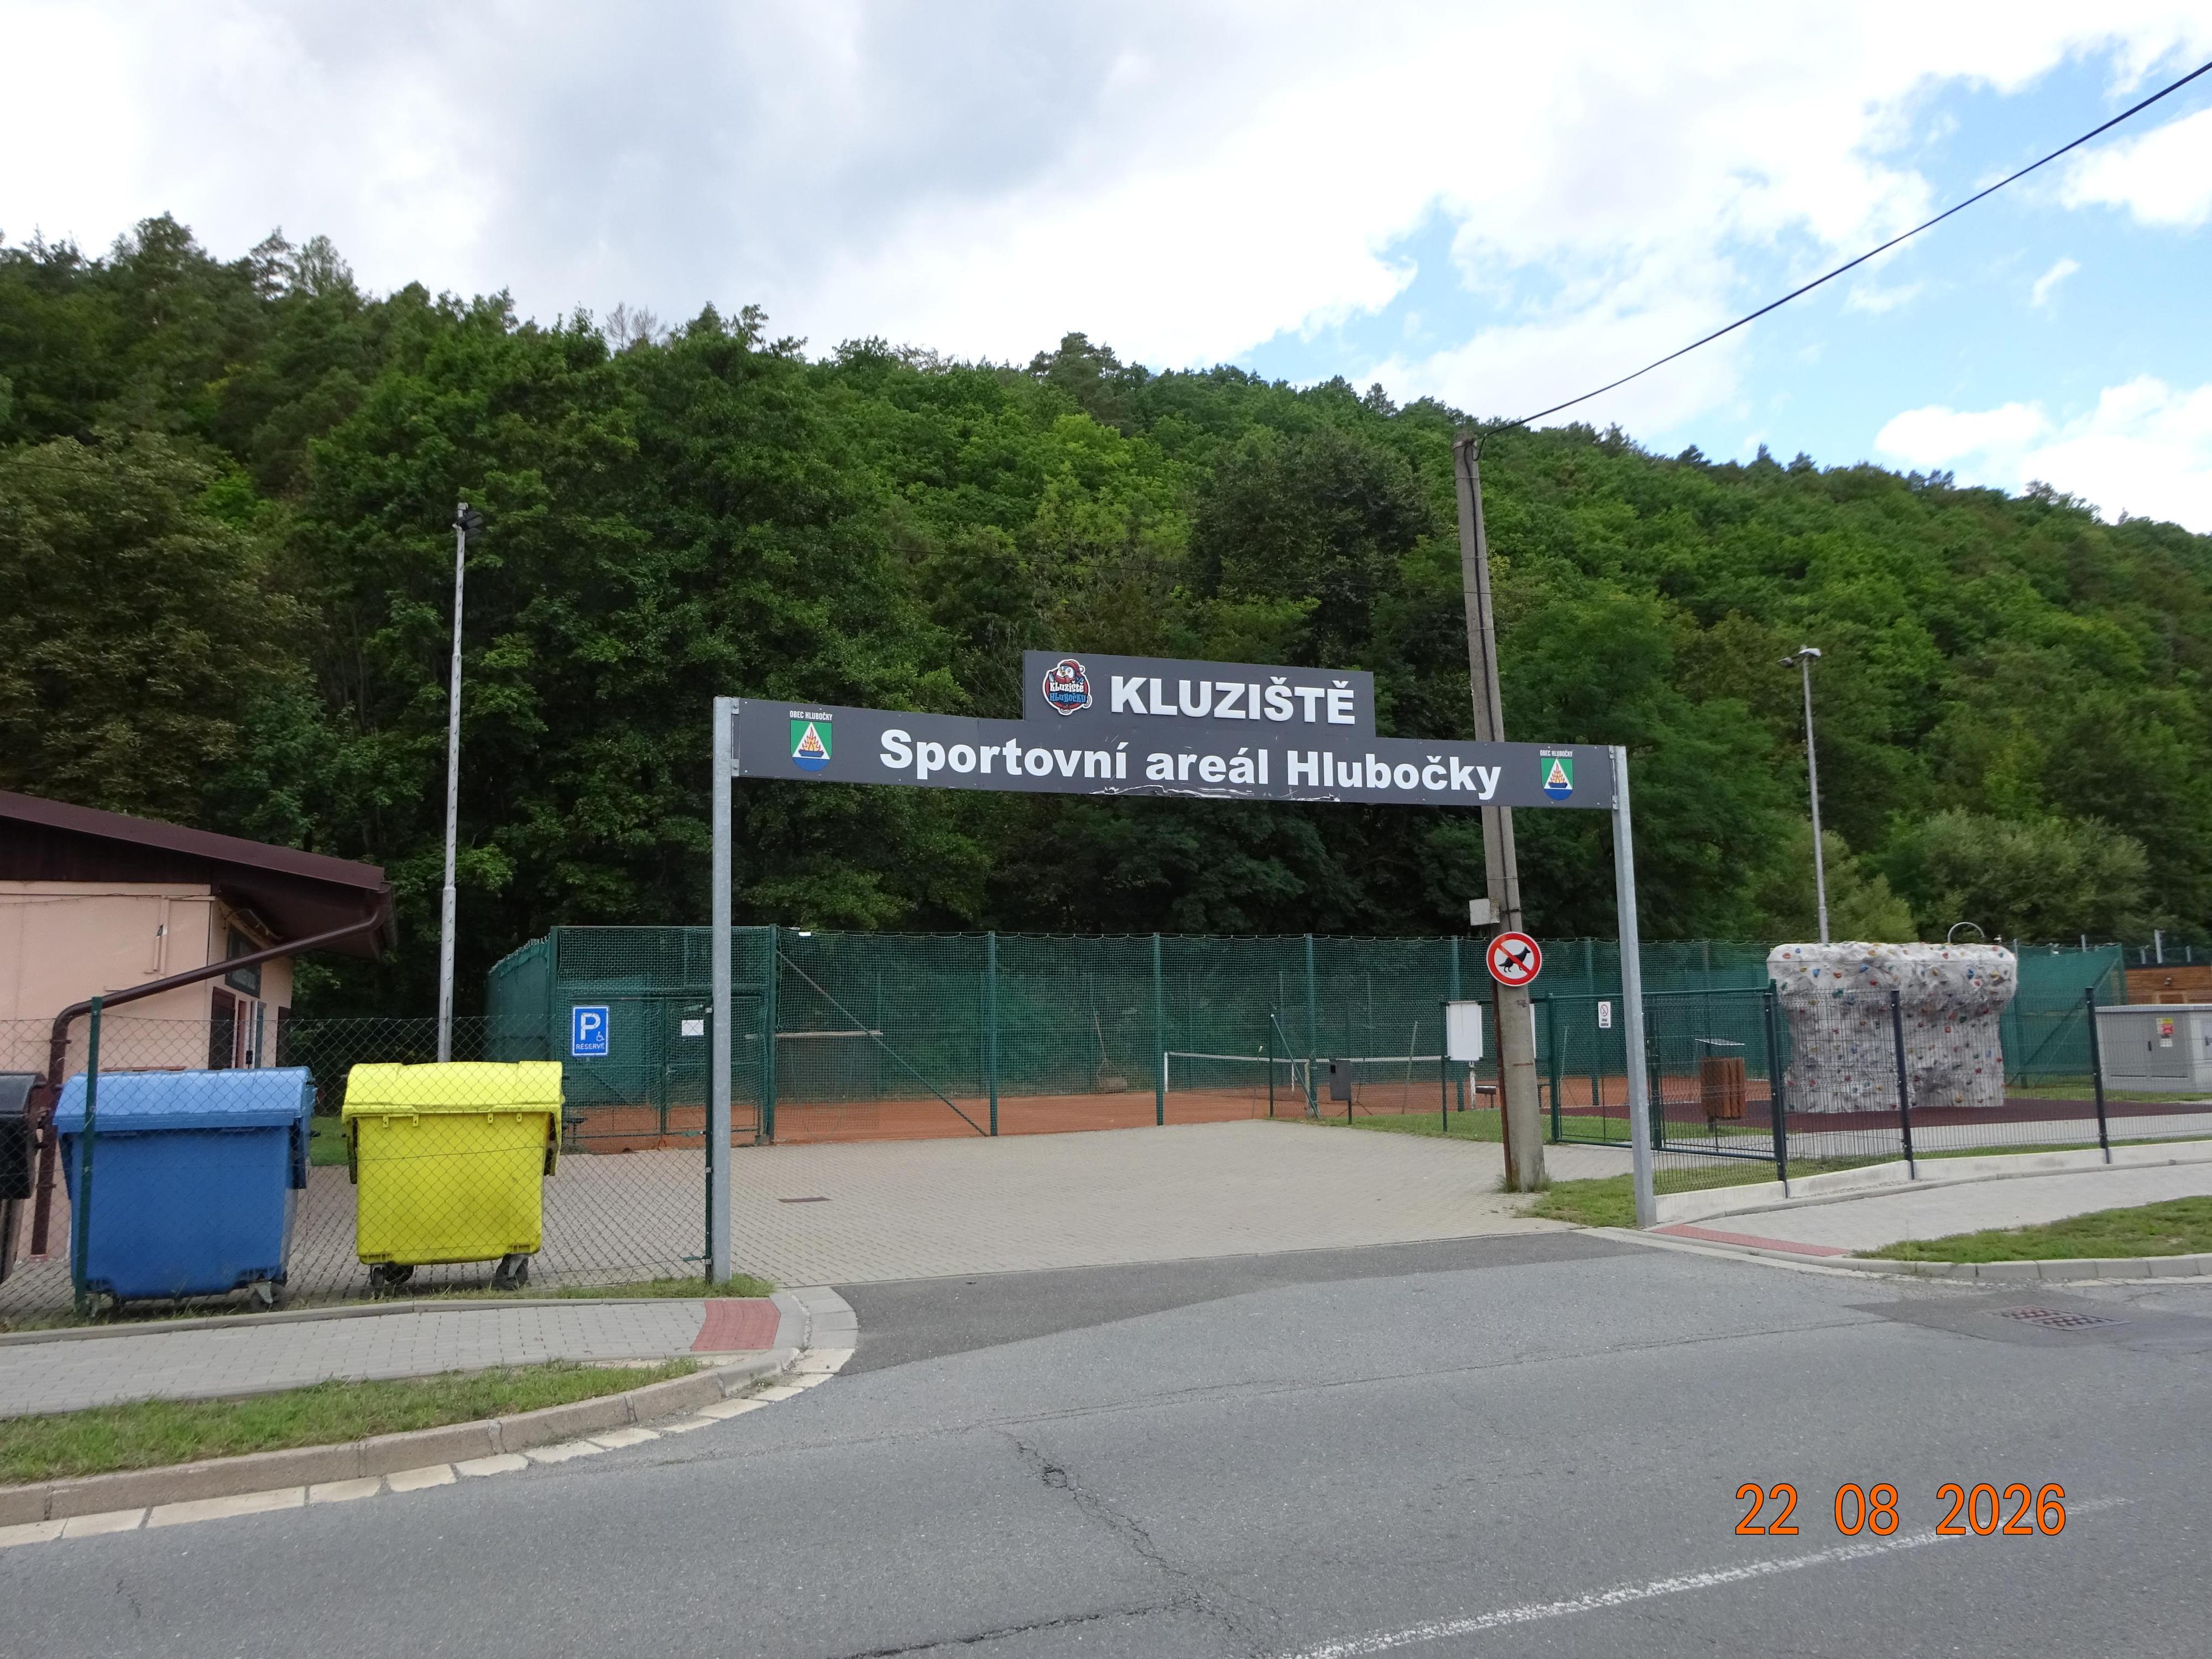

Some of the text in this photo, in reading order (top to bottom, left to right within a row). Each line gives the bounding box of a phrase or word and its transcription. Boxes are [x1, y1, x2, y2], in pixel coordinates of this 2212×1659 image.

[805, 712, 833, 721] HLUBOČKY
[1111, 676, 1355, 725] KLUZIŠTĚ
[879, 729, 1501, 800] Sportovní areál Hlubočky
[581, 1013, 601, 1041] P
